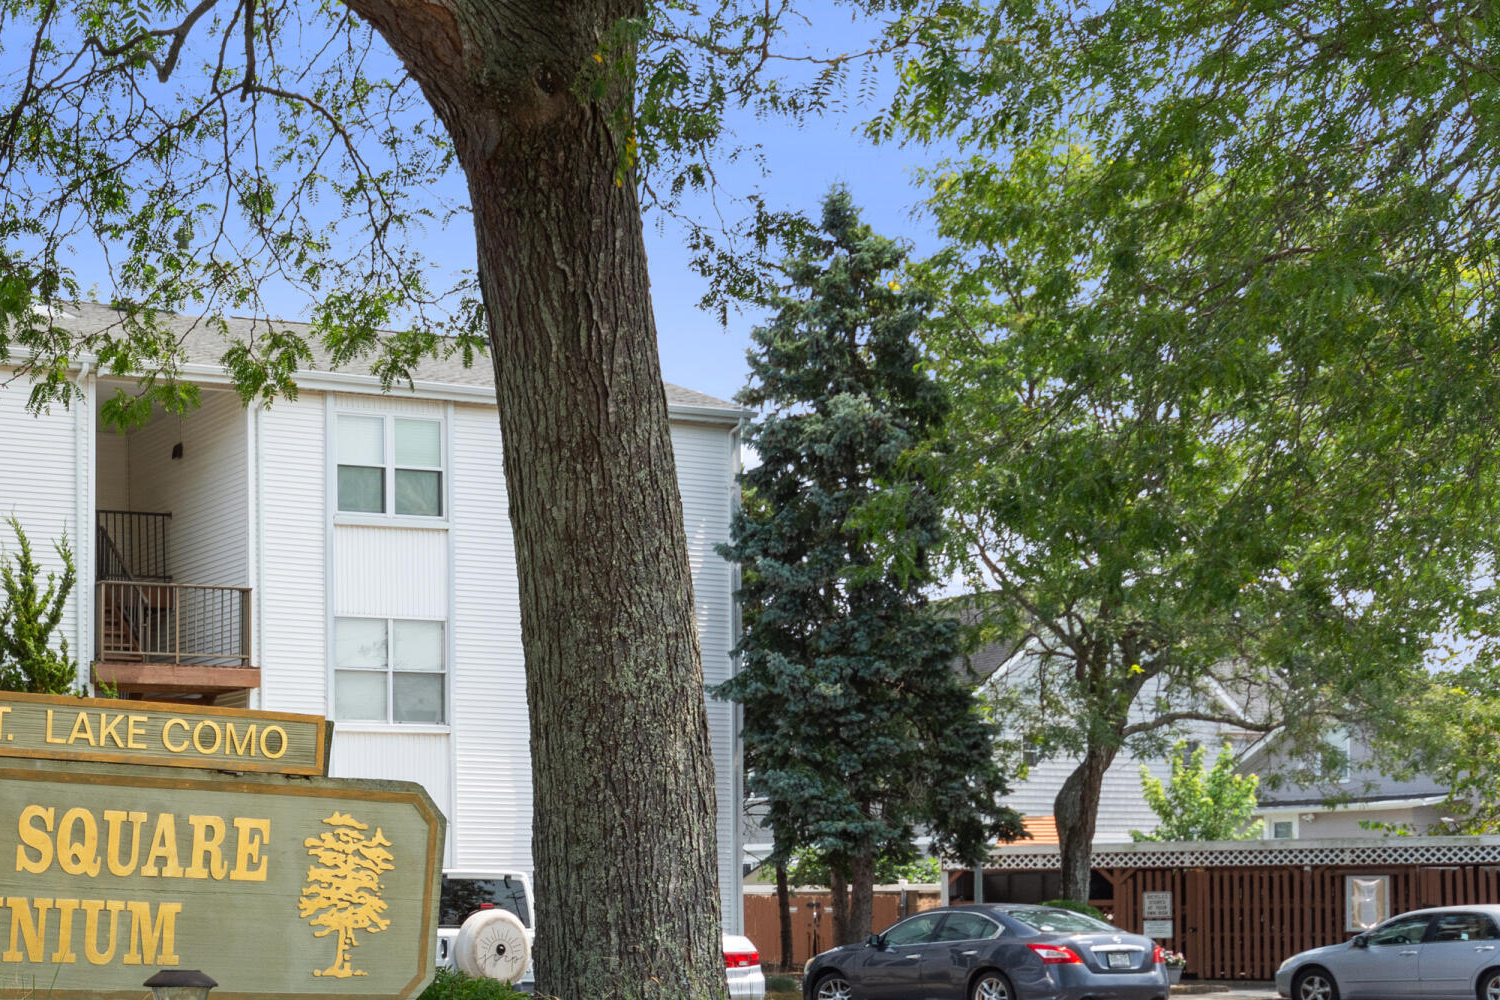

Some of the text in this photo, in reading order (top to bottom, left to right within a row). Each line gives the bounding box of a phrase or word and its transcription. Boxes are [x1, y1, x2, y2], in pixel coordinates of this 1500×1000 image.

[45, 708, 148, 750] LAKE
[162, 716, 288, 760] COMO
[16, 804, 271, 882] SQUARE
